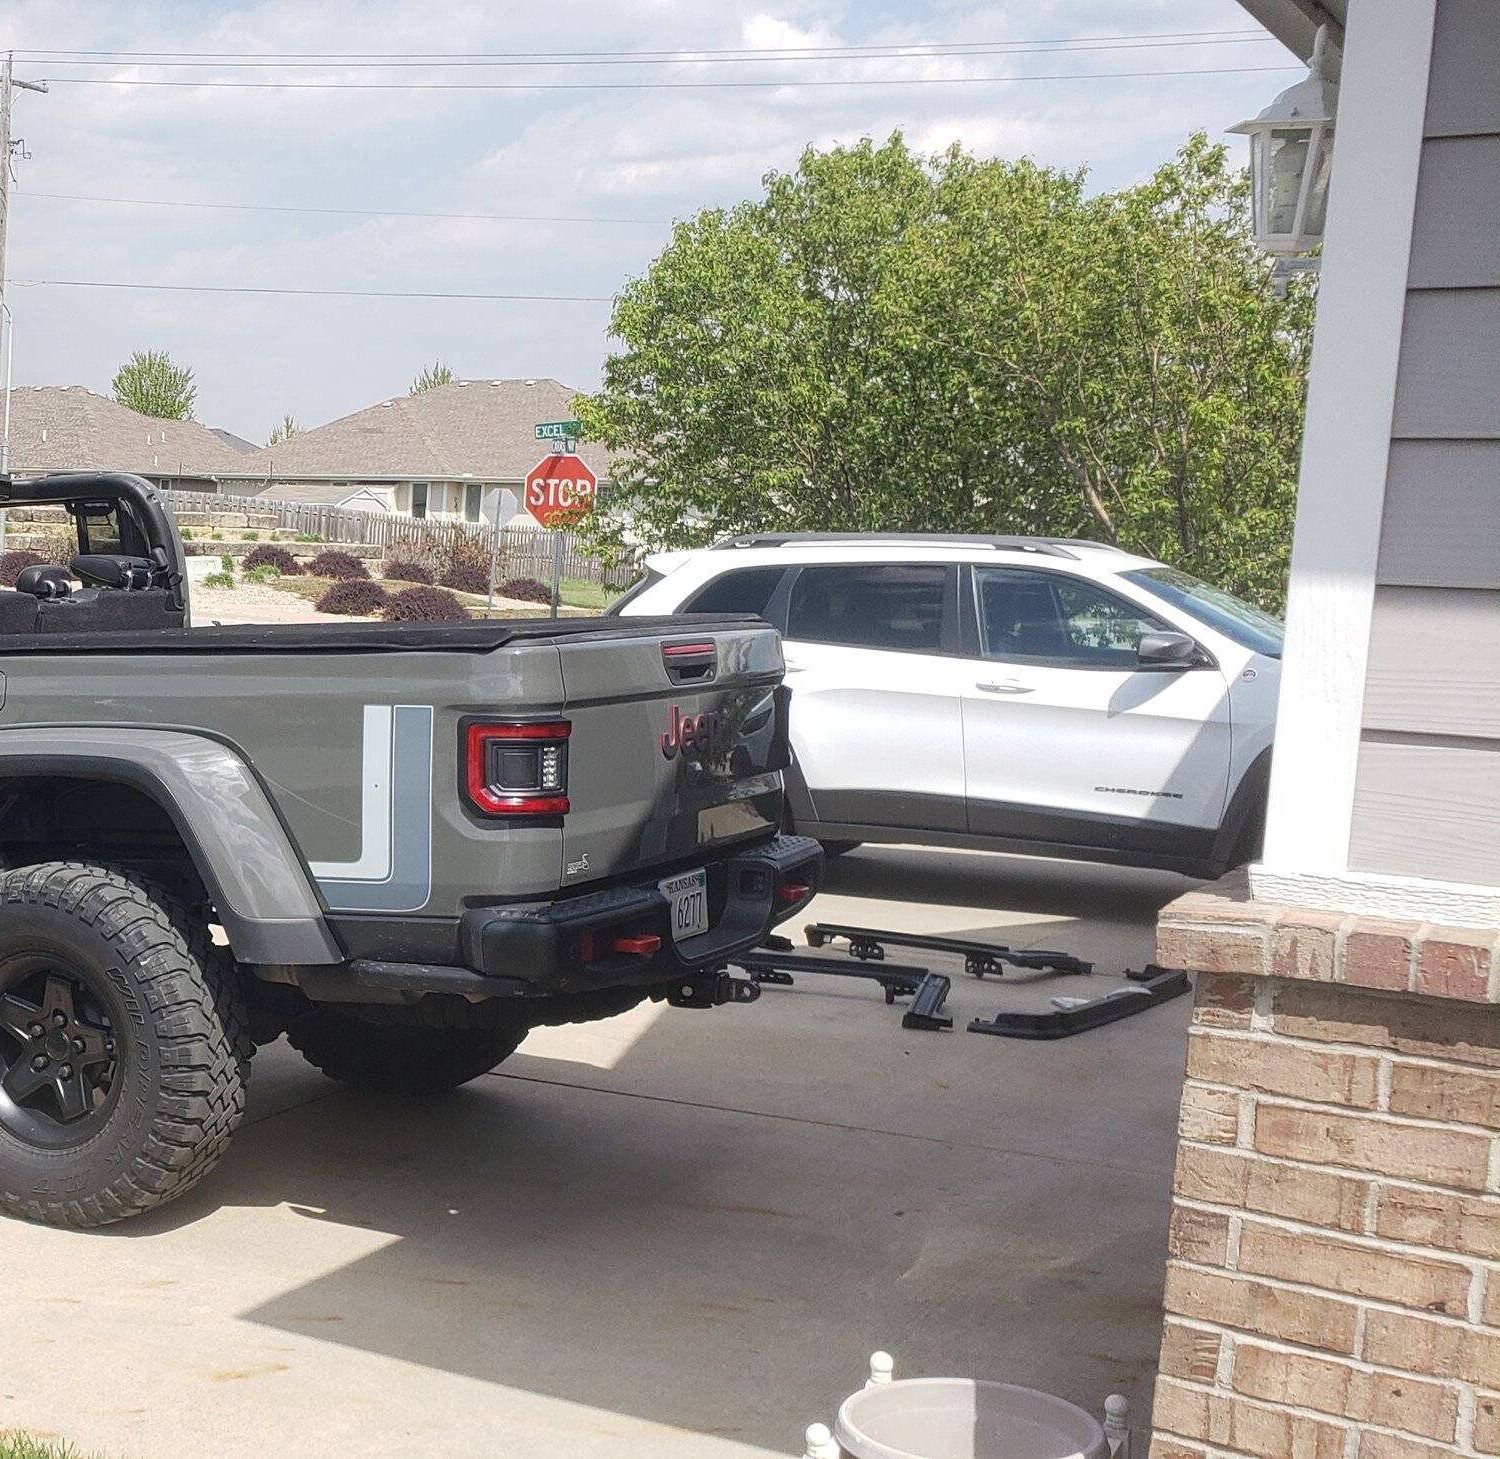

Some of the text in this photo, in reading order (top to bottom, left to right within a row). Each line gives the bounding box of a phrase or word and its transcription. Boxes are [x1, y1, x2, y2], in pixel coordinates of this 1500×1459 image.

[535, 424, 566, 438] EXCEL
[529, 478, 592, 507] STOP
[1094, 786, 1184, 800] CHEROKEE
[668, 875, 696, 894] KANSAS
[677, 892, 702, 929] 6277
